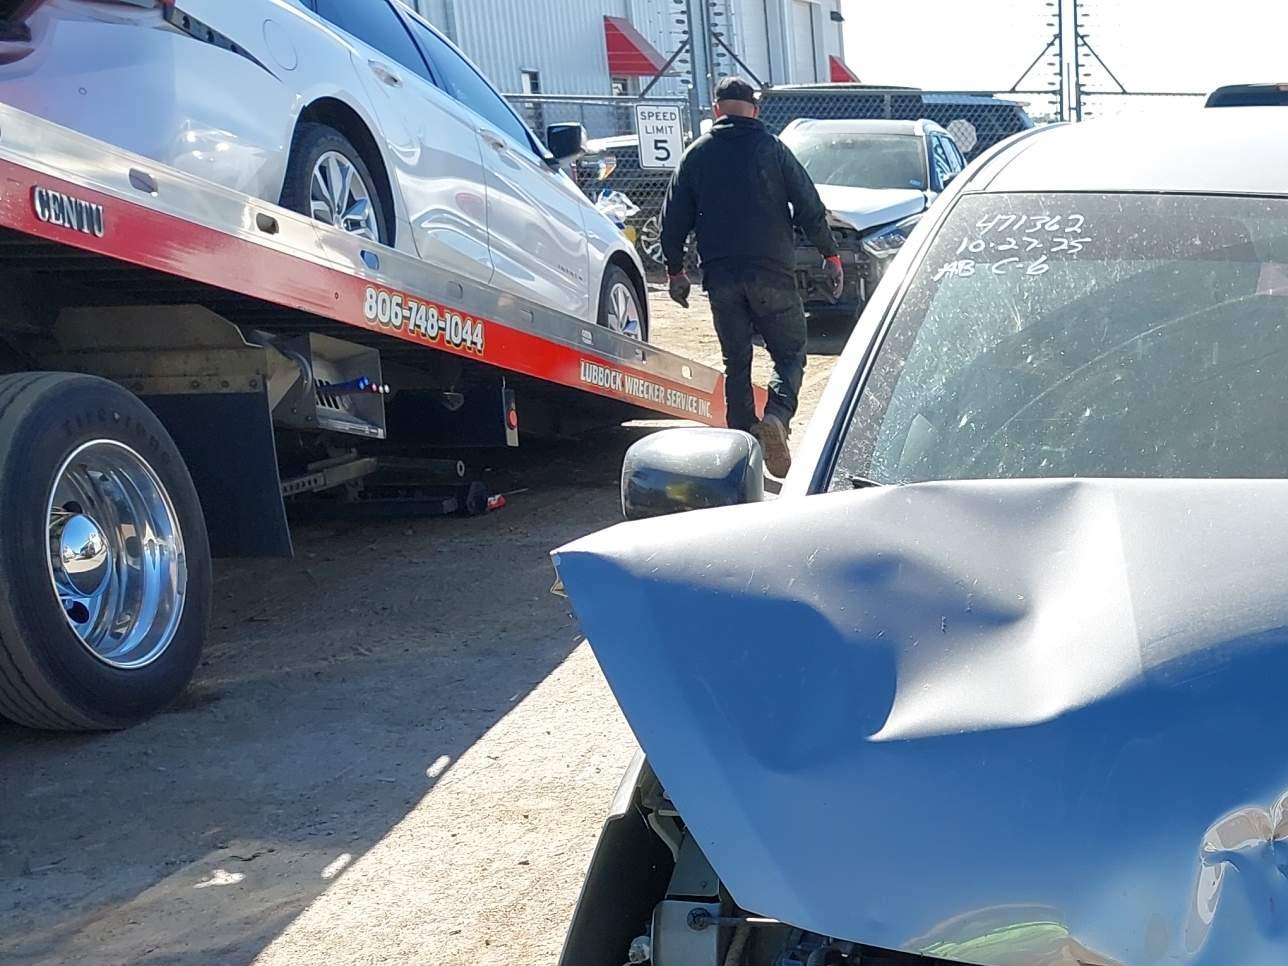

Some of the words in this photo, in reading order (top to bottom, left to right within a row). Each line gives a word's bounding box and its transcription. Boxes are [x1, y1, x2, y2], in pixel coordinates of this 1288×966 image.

[640, 111, 677, 121] SPEED
[645, 125, 674, 135] LIMIT
[654, 139, 671, 161] 5
[31, 186, 104, 238] CENTU
[976, 214, 1085, 237] 471362
[364, 286, 484, 353] 806-748-1044
[580, 361, 622, 392] LUBBOCK
[624, 375, 665, 403] WRECKER
[667, 389, 697, 414] SERVICE
[698, 398, 713, 418] INC.
